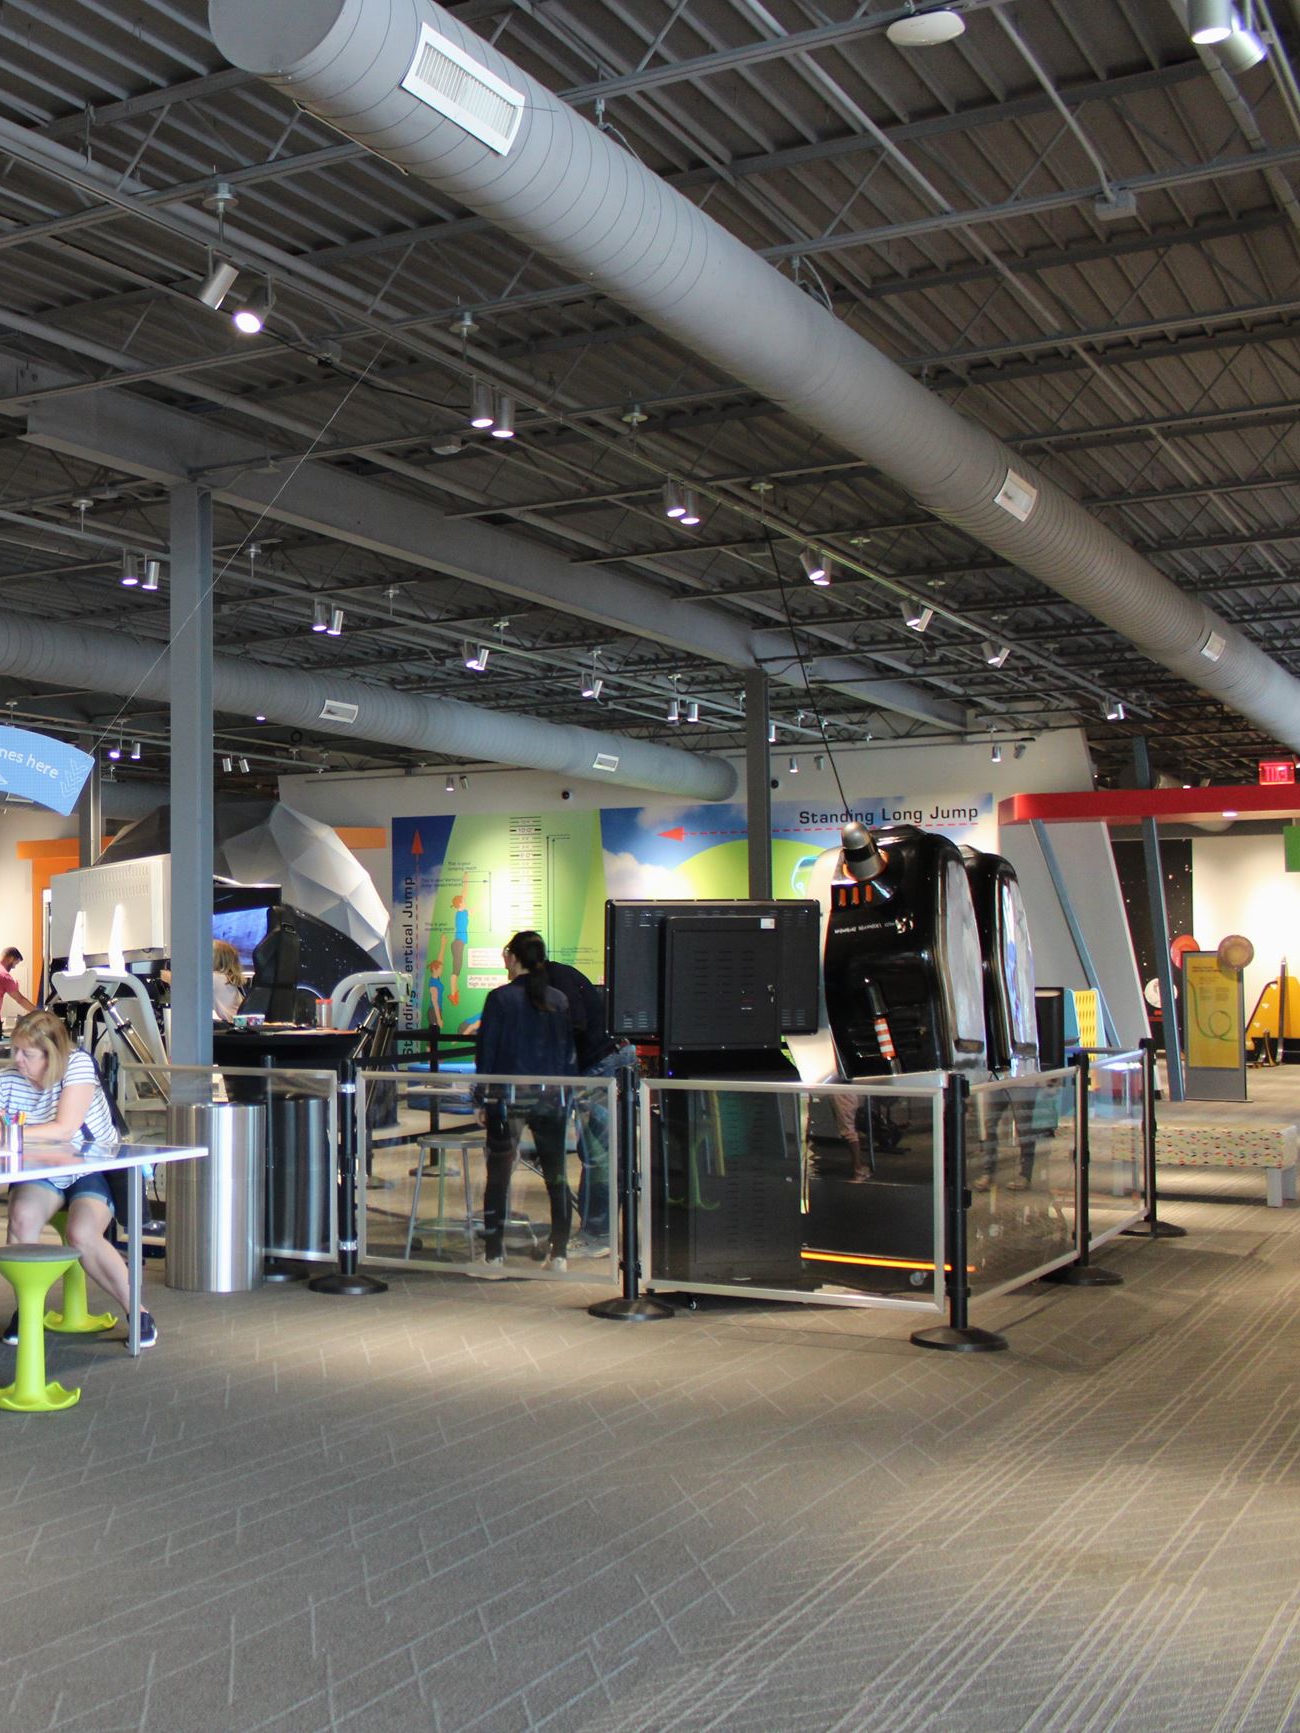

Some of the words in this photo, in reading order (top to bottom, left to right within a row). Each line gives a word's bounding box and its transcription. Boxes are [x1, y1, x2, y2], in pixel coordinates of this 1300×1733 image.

[26, 753, 59, 779] here
[799, 809, 874, 826] Standing
[882, 808, 922, 823] Long
[930, 806, 979, 822] Jump
[402, 877, 416, 919] Jump
[402, 924, 413, 973] ertical
[402, 990, 416, 1056] Stndin
